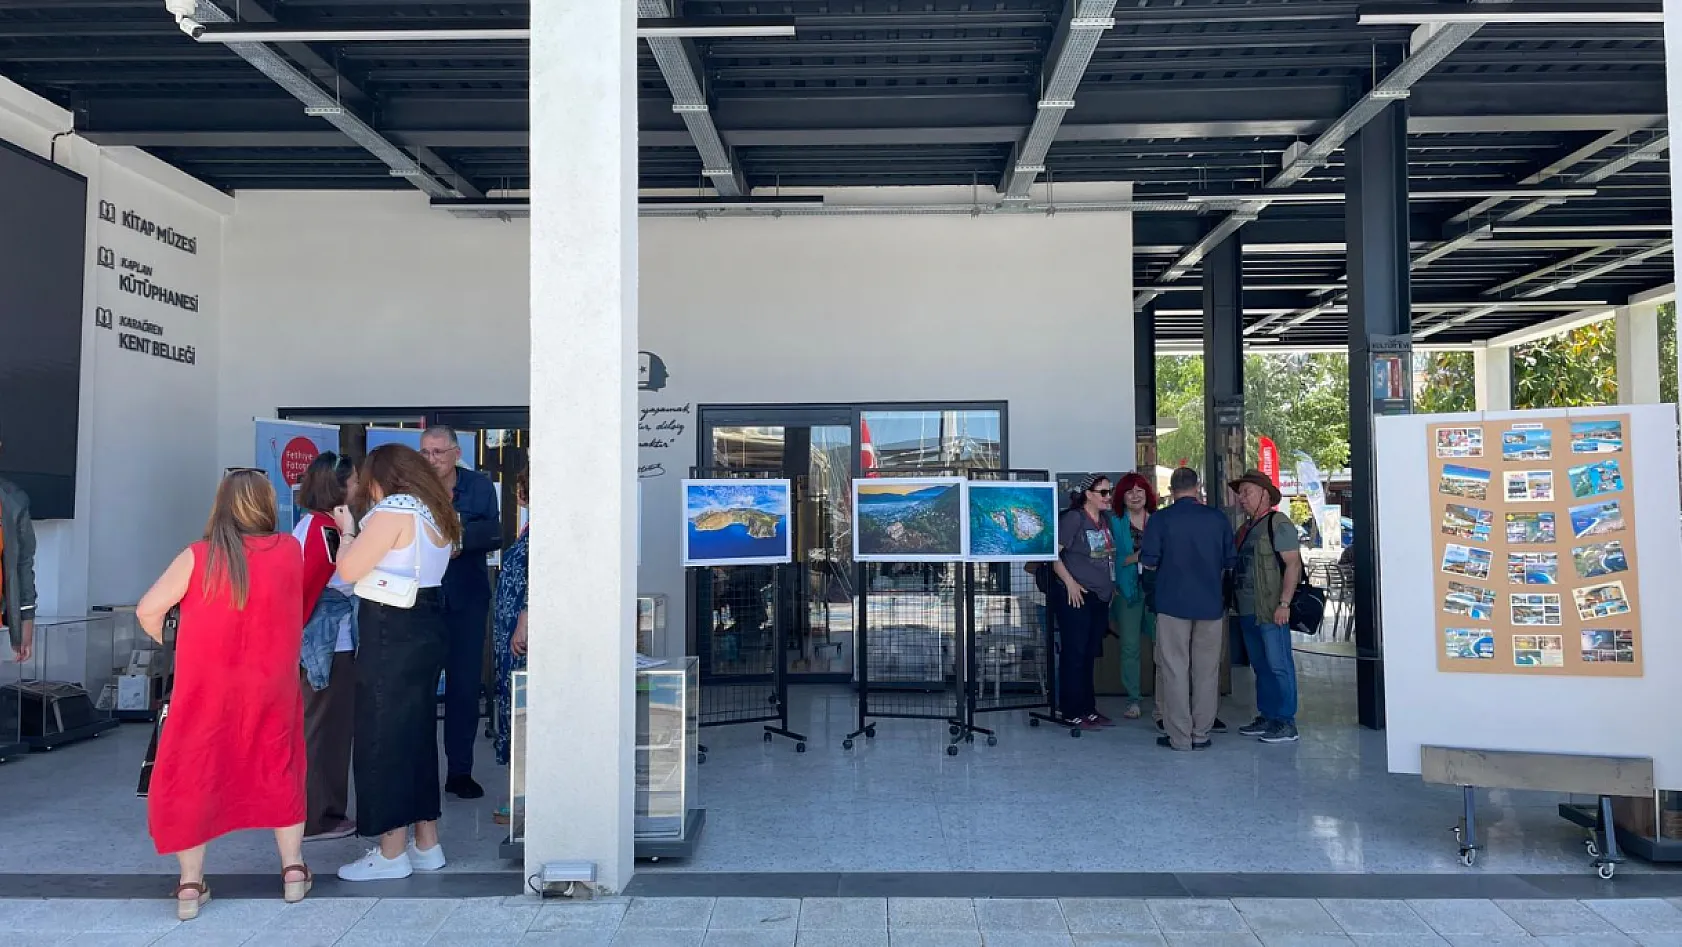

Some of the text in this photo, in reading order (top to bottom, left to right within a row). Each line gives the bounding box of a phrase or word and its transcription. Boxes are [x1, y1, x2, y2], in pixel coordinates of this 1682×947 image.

[122, 210, 197, 254] KİTAP MÜZESİ
[120, 257, 153, 276] KAPLAN
[119, 273, 199, 312] KÜTÜPHANESİ
[118, 332, 196, 365] KENT BELLEĞİ
[286, 450, 313, 461] Fethiye
